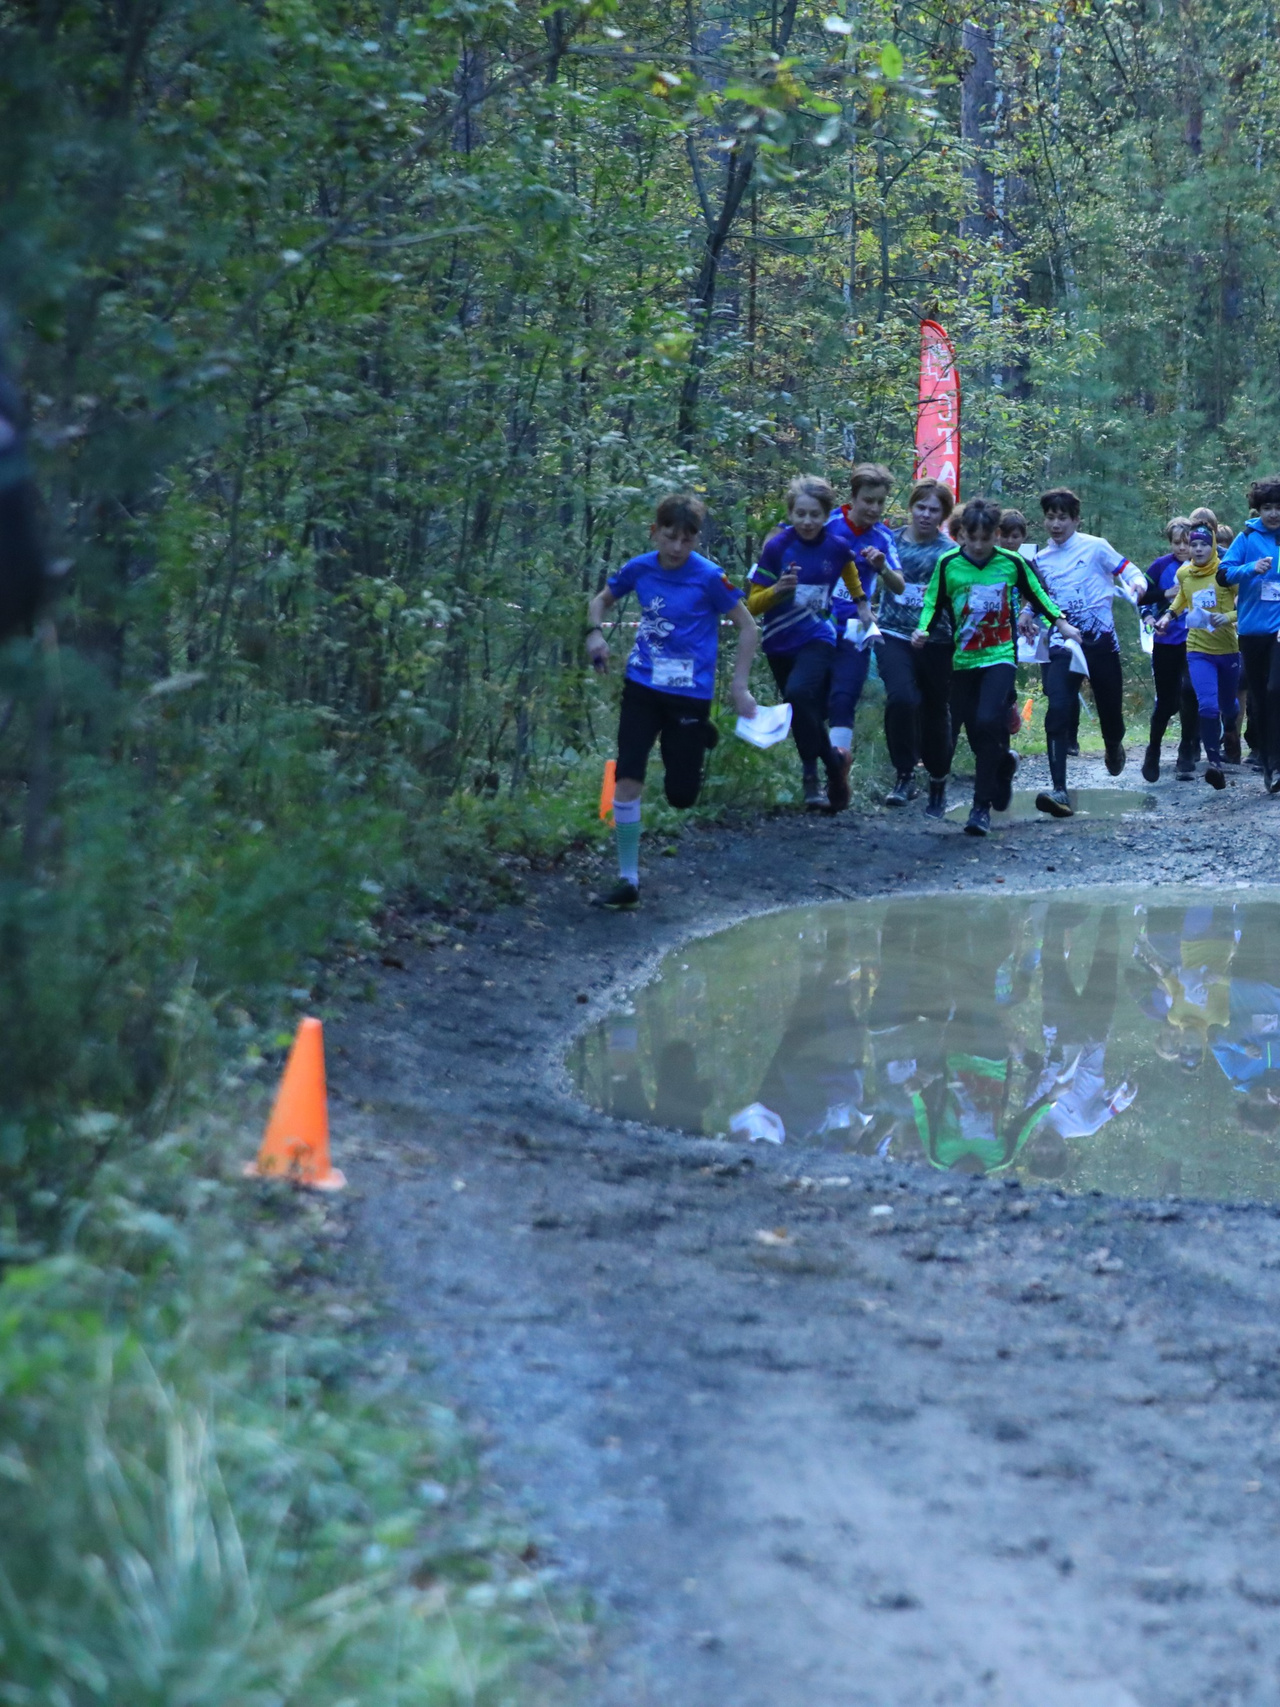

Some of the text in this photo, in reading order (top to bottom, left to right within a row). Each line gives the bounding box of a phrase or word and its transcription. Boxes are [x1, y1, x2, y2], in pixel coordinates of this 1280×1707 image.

[905, 596, 922, 606] 302
[983, 601, 1000, 611] 304
[1067, 599, 1084, 609] 325
[1201, 600, 1216, 608] 333
